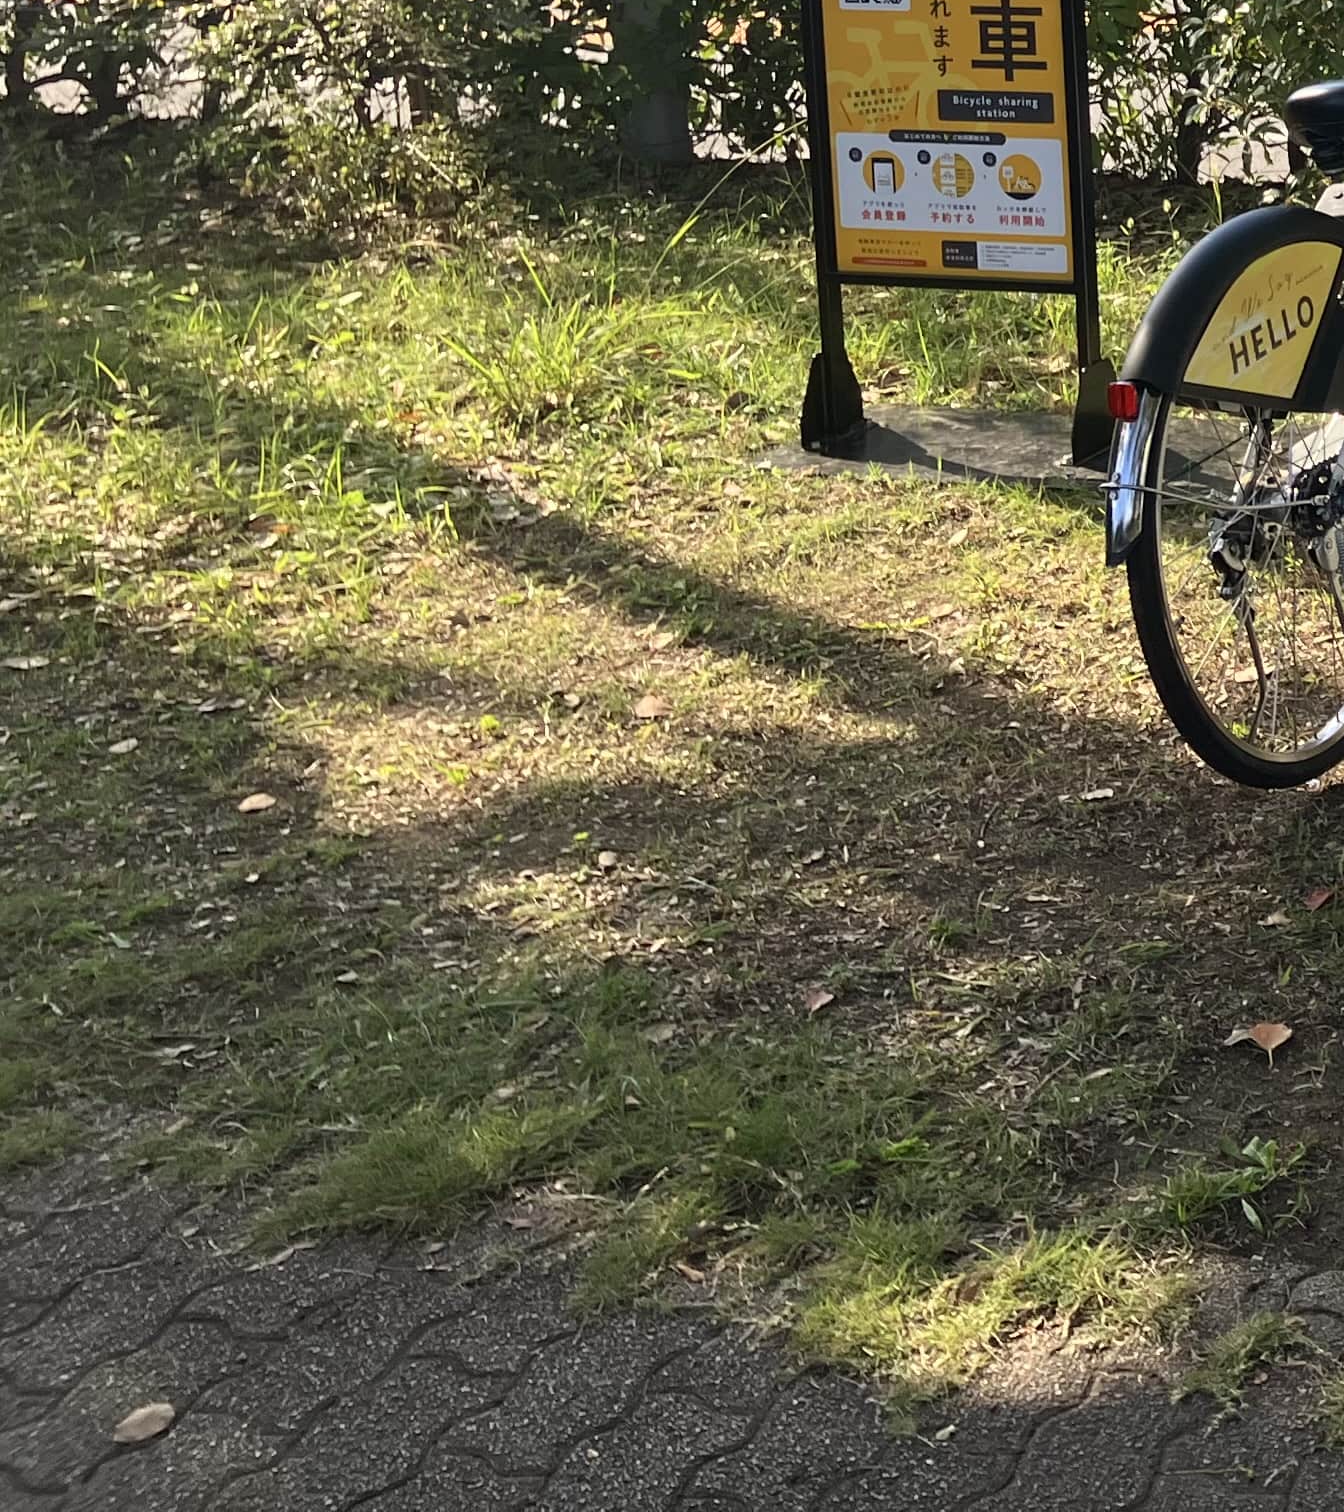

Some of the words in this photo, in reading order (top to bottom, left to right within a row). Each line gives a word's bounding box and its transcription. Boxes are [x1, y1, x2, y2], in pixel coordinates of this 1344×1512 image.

[952, 94, 993, 110] Bicycle
[997, 95, 1039, 111] sharing
[976, 108, 1016, 119] station
[929, 212, 976, 225] 予約する
[998, 214, 1046, 228] 利用開始
[1228, 295, 1314, 375] HELLO
